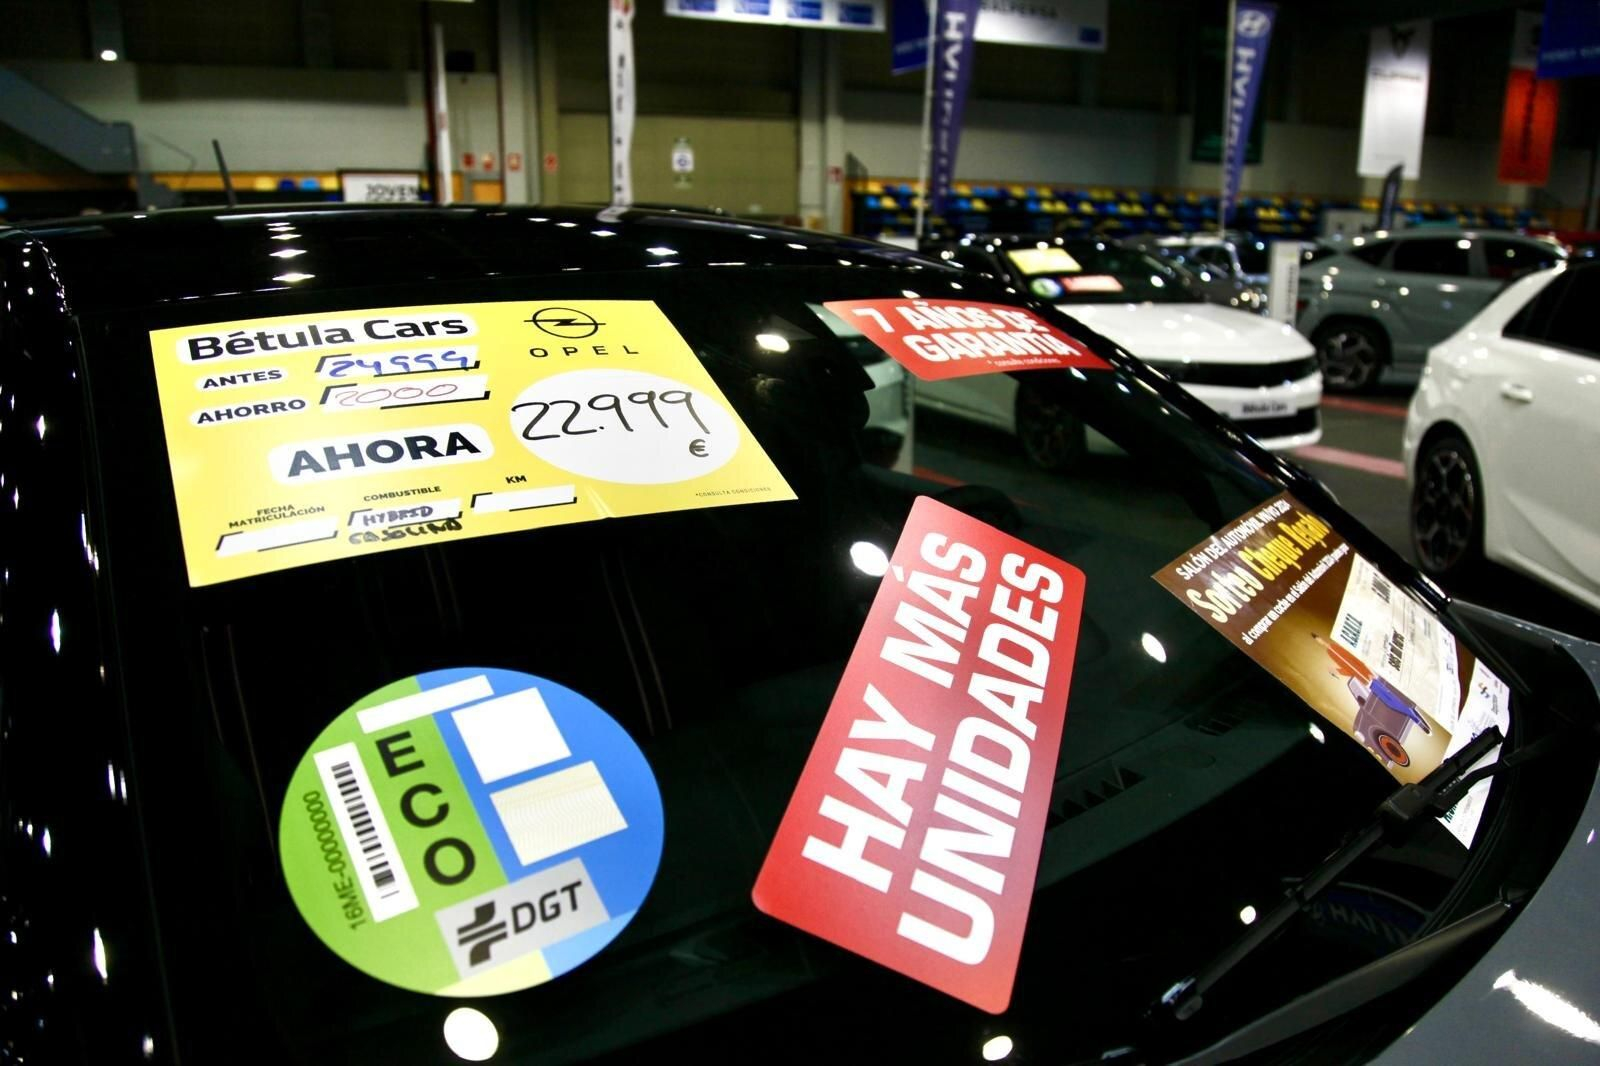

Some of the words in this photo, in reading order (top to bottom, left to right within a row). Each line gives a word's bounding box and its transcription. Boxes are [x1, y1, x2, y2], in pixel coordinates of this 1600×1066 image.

[852, 307, 895, 333] 7
[896, 301, 1005, 331] AÑOS
[991, 308, 1051, 333] DE
[187, 324, 355, 361] Bétula
[363, 316, 469, 341] Cars
[529, 345, 639, 359] OPEL
[203, 369, 283, 389] ANTES
[335, 383, 458, 407] 2000
[197, 399, 306, 425] AHORRO
[511, 390, 711, 441] 22.999
[287, 431, 482, 478] AHORA
[688, 438, 709, 458] €
[363, 485, 442, 502] COMBUSTIBLE
[505, 475, 527, 486] KM
[228, 506, 326, 529] MATRICULACIÓN
[256, 504, 295, 516] FECHA
[1175, 551, 1213, 581] SALÓN
[1203, 541, 1229, 560] DEL
[1220, 516, 1265, 550] AUTOMÓVIL
[1186, 565, 1264, 623] Sorteo
[1237, 534, 1303, 581] Cheque
[1277, 510, 1330, 550] Regalo
[801, 683, 937, 894] HAY
[879, 532, 987, 690] MÁS
[897, 552, 1065, 967] UNIDADES
[375, 730, 476, 886] ECO
[511, 880, 584, 935] DGT
